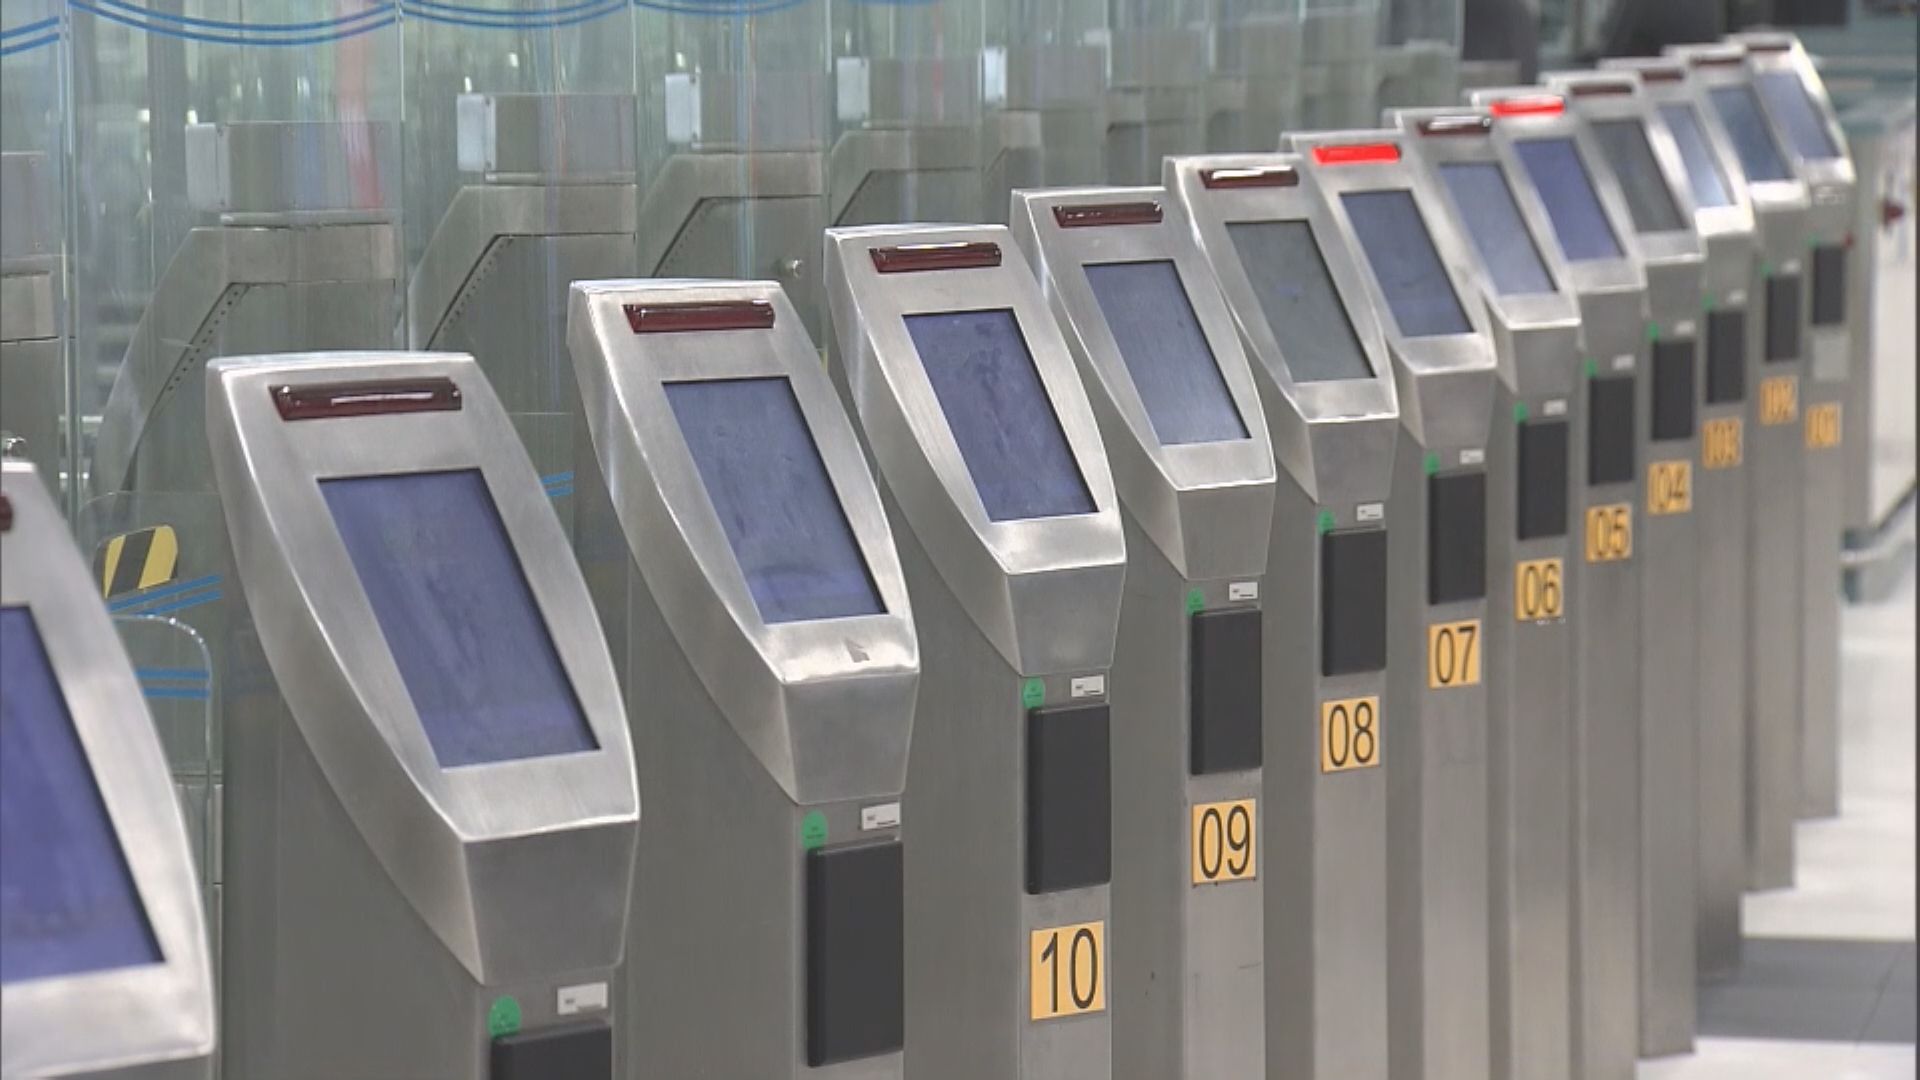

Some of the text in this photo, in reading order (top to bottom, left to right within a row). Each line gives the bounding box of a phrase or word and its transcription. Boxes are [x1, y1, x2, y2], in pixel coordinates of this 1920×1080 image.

[1654, 465, 1688, 510] 04
[1594, 507, 1629, 558] 05
[1523, 563, 1560, 617] 06
[1434, 625, 1477, 684] 07
[1328, 701, 1374, 768] 08
[1198, 804, 1251, 879] 09
[1040, 927, 1098, 1013] 10
